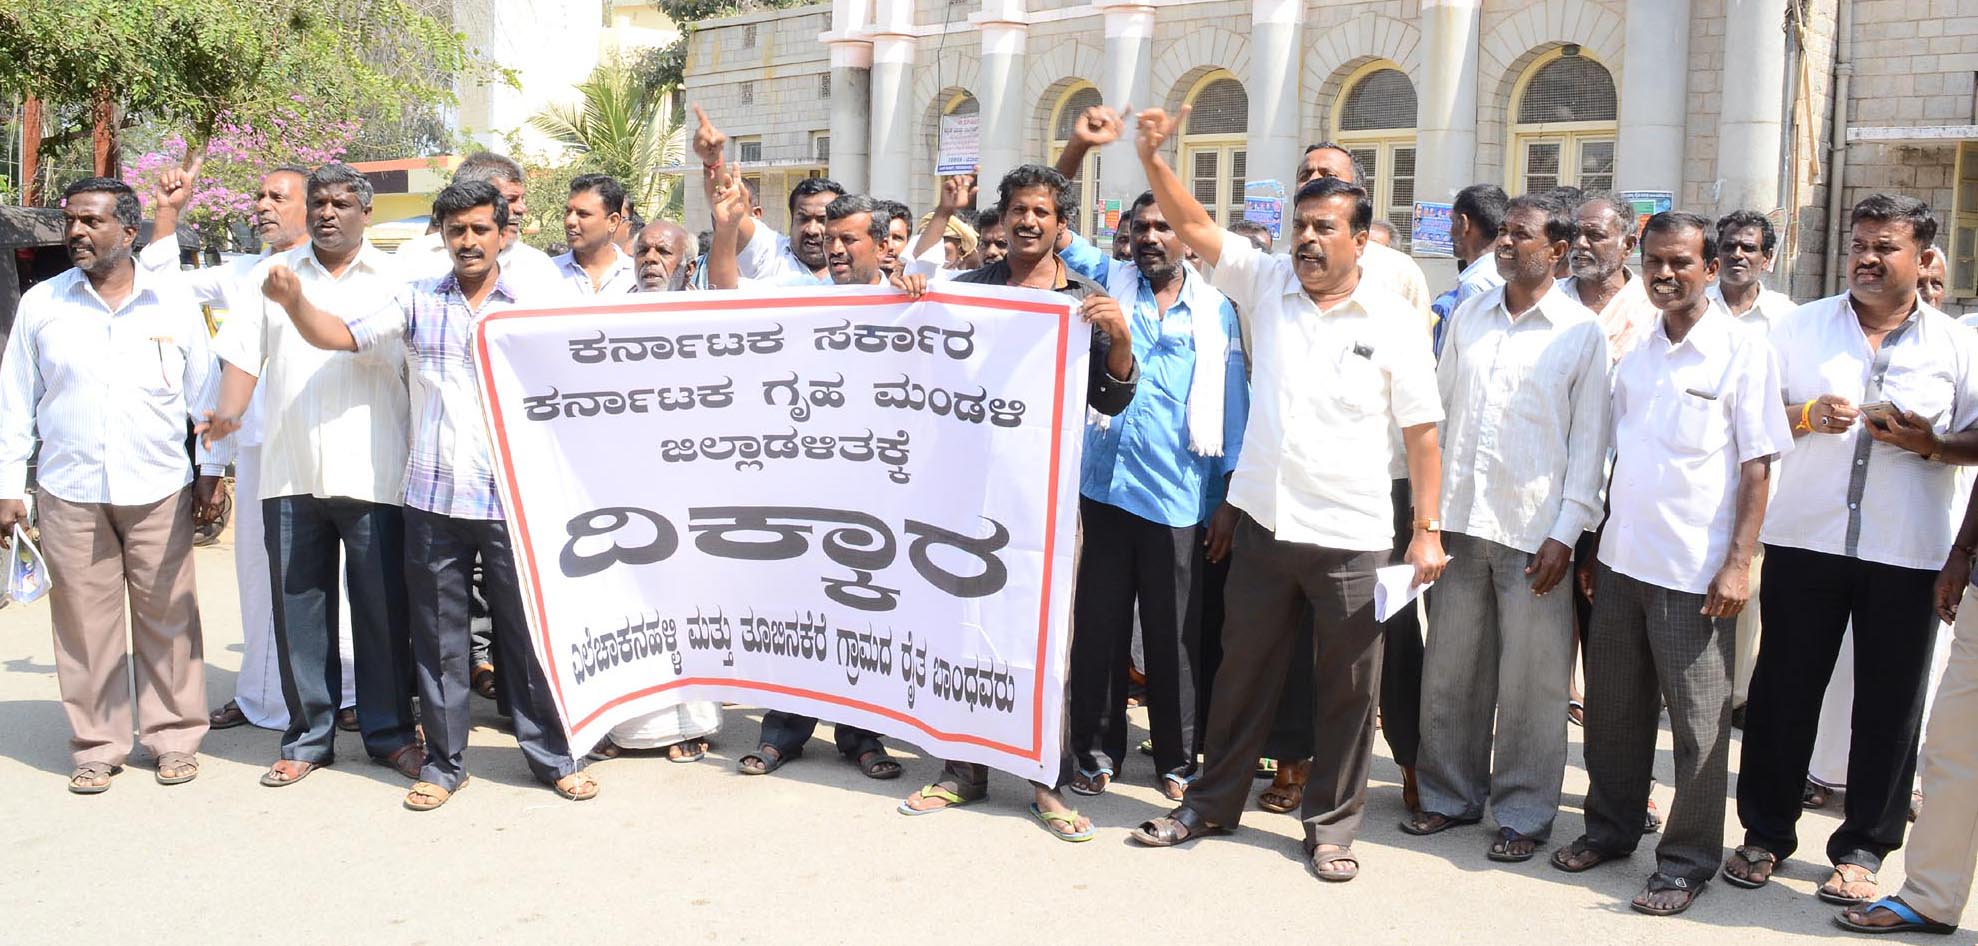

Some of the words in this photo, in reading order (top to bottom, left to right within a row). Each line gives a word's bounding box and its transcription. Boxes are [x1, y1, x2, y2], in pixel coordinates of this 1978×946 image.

[568, 323, 785, 364] ಕರ್ನಾಟಕ
[813, 318, 975, 360] ಸರ್ಕಾರ
[523, 375, 735, 422] ಕರ್ನಾಟಕ
[762, 370, 846, 423] ಗೃಹ
[873, 372, 1027, 429] ಮಂಡಳಿ
[660, 425, 912, 485] ಜಿಲ್ಲಾಡಳಿತಕ್ಕೆ
[558, 506, 1011, 612] ದಿಕ್ಕಾರ
[686, 604, 734, 667] ಮತ್ತು
[740, 605, 828, 663] ತೂಬಿನಕೆರೆ
[836, 620, 893, 687] ಗ್ರಾಮದ
[901, 630, 928, 710] ರೈತ
[932, 654, 1016, 714] ಬಾಂಧವರು
